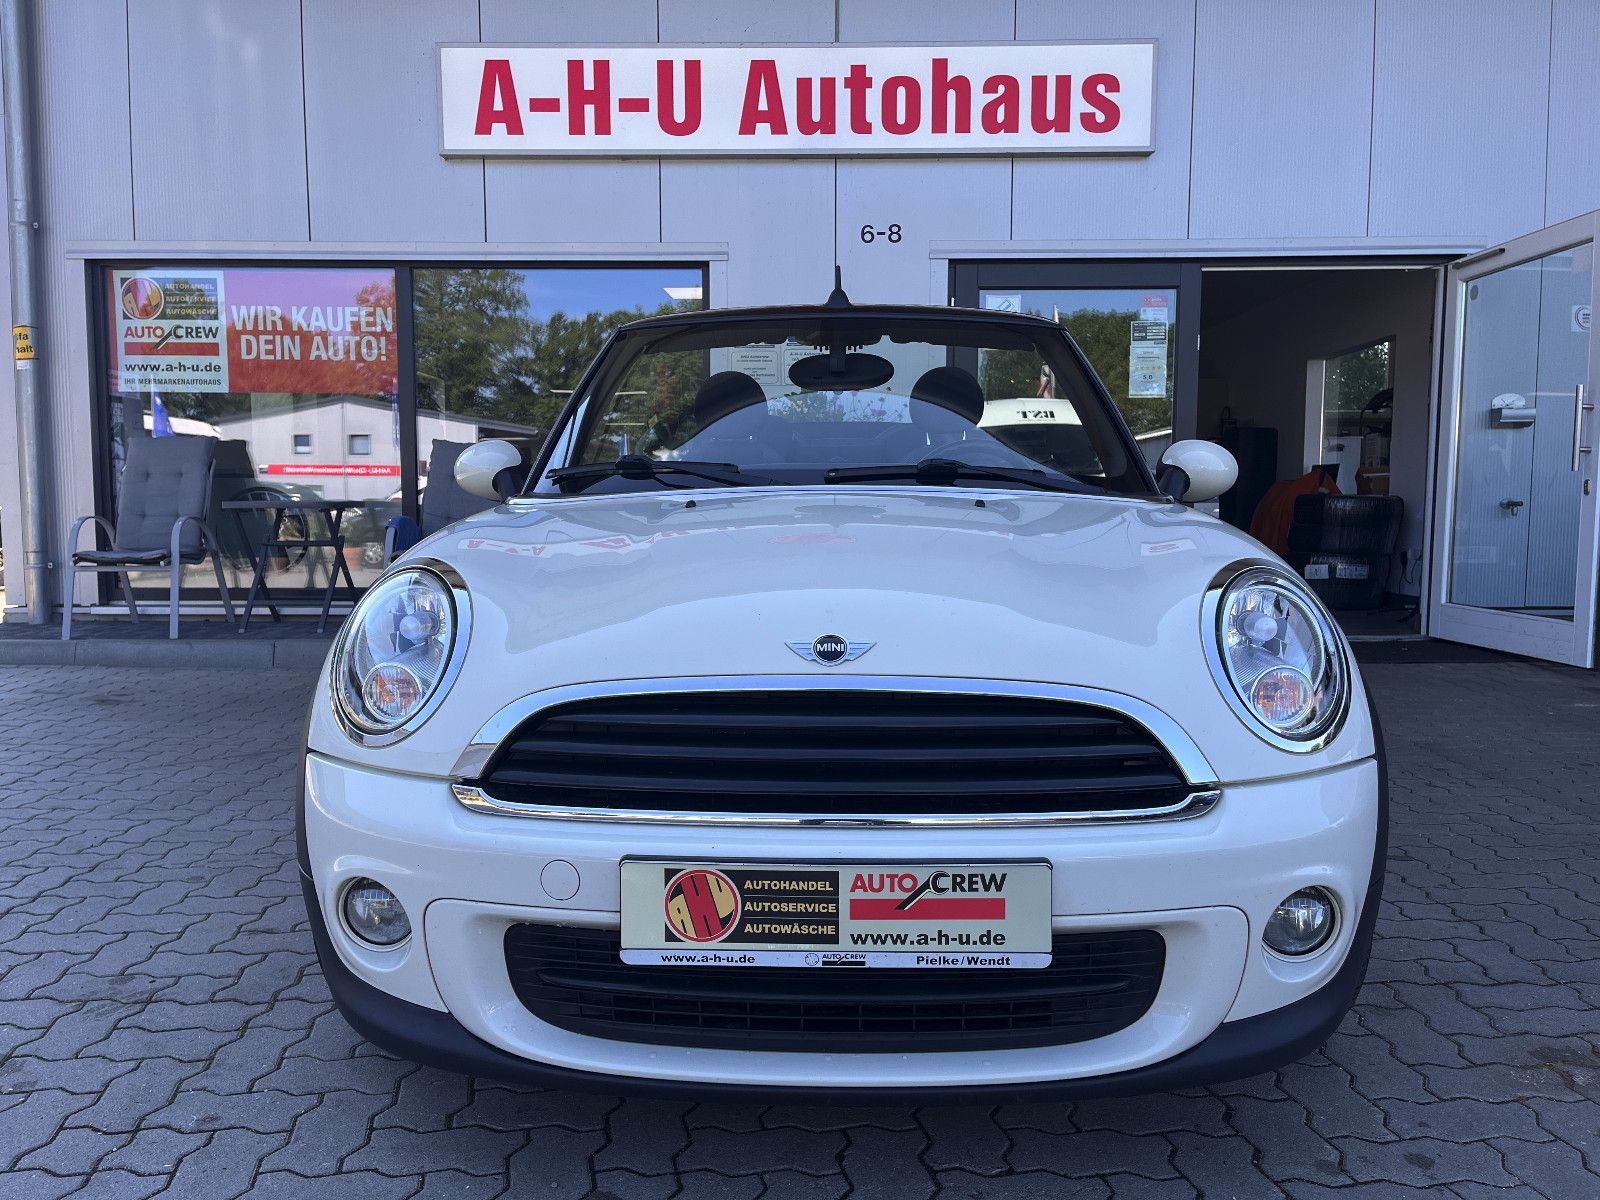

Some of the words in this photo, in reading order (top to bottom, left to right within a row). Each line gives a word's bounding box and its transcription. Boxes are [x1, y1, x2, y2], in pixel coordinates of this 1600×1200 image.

[475, 59, 702, 137] A-H-U
[738, 58, 1122, 136] Autohaus
[860, 224, 902, 244] 6-8
[231, 305, 283, 331] WIR
[291, 306, 393, 333] KAUFEN
[240, 335, 301, 361] DEIN
[309, 335, 387, 362] AUTO!
[125, 362, 222, 372] www.a-h-u.de
[124, 378, 136, 386] IHR
[138, 378, 222, 386] MEHRMARKENAUTOHAUS
[816, 642, 845, 652] MINI
[743, 880, 834, 892] AUTOHANDEL
[743, 902, 837, 913] AUTOSERVICE
[743, 923, 836, 935] AUTOWÄSCHE
[850, 930, 1006, 946] www.a-h-u.de
[661, 953, 756, 964] www.a-h-u.de
